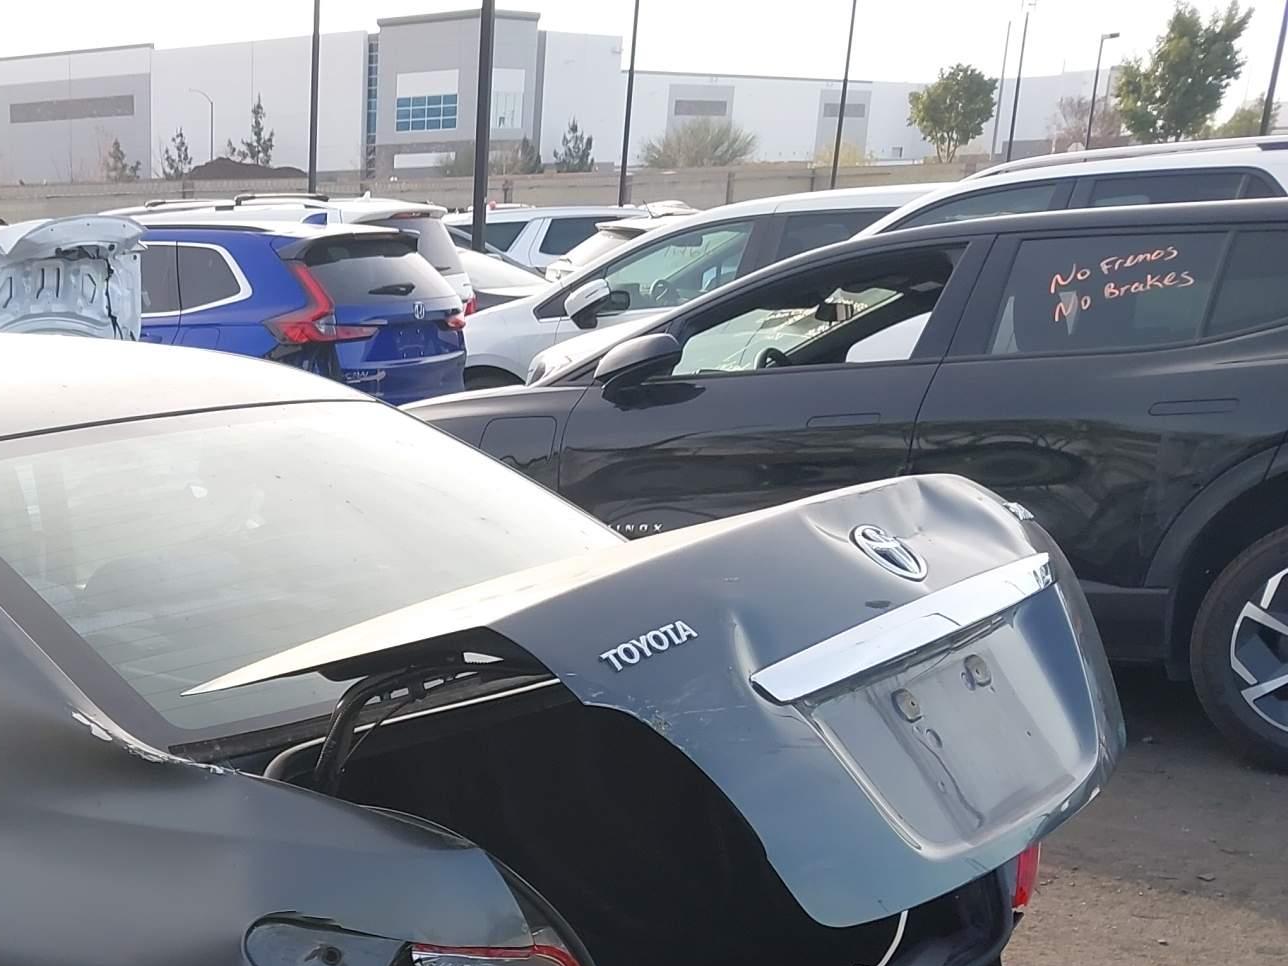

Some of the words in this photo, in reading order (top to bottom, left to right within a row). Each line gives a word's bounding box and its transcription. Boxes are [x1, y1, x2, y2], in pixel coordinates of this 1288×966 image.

[1050, 263, 1091, 294] No
[1104, 271, 1195, 299] Brakes
[608, 523, 663, 533] INOX
[599, 620, 698, 672] TOYOTA
